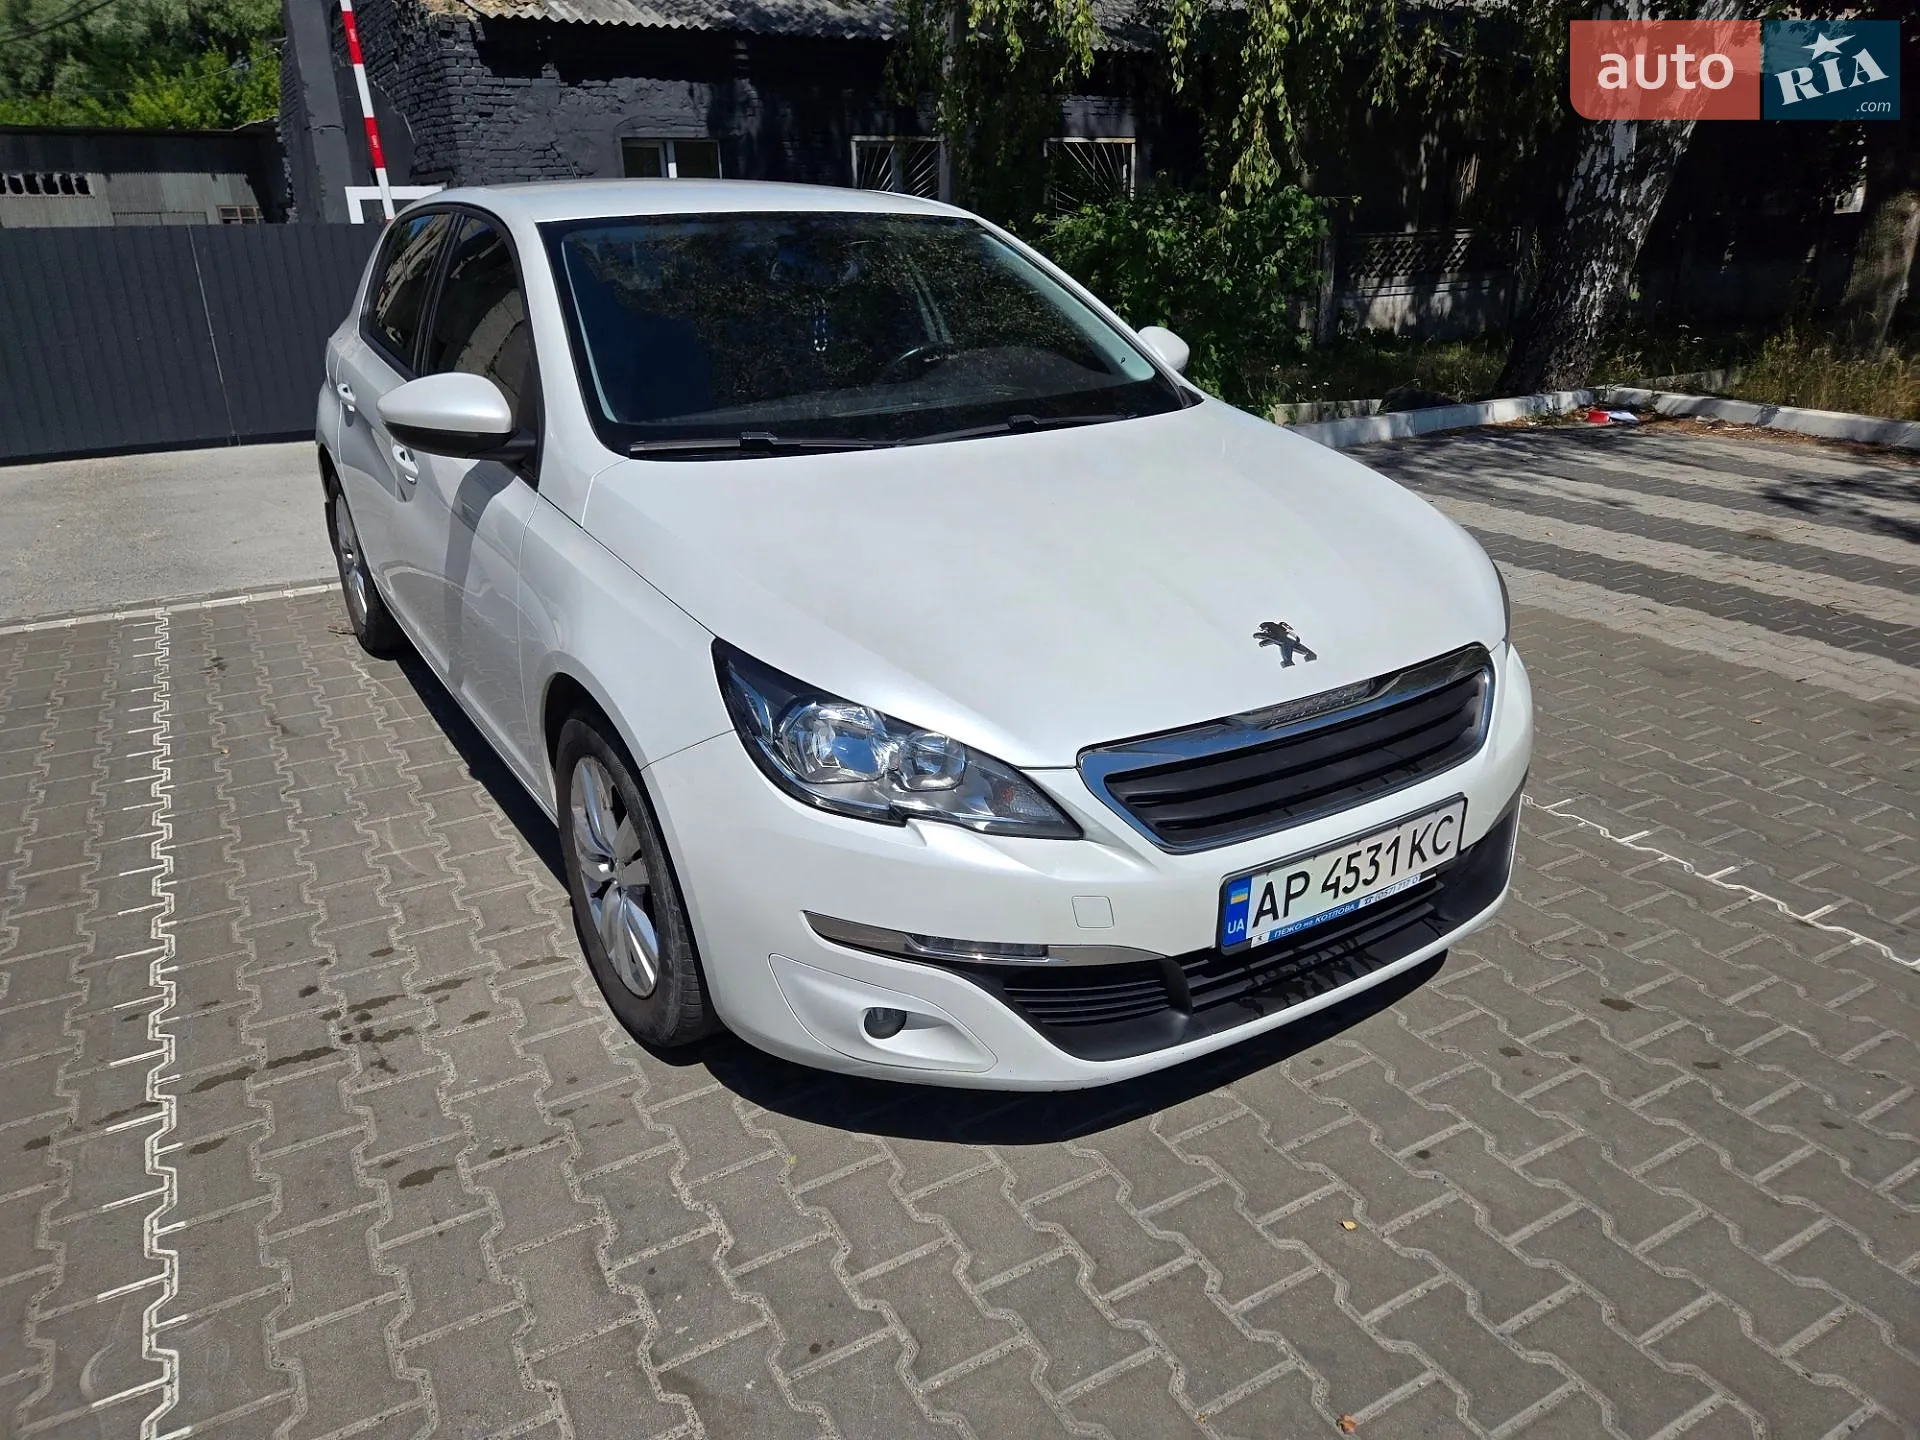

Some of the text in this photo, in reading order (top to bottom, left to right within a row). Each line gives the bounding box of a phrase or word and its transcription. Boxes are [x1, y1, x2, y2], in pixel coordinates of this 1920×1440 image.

[1252, 814, 1455, 929] AP 4531 KC
[1227, 917, 1245, 935] UA
